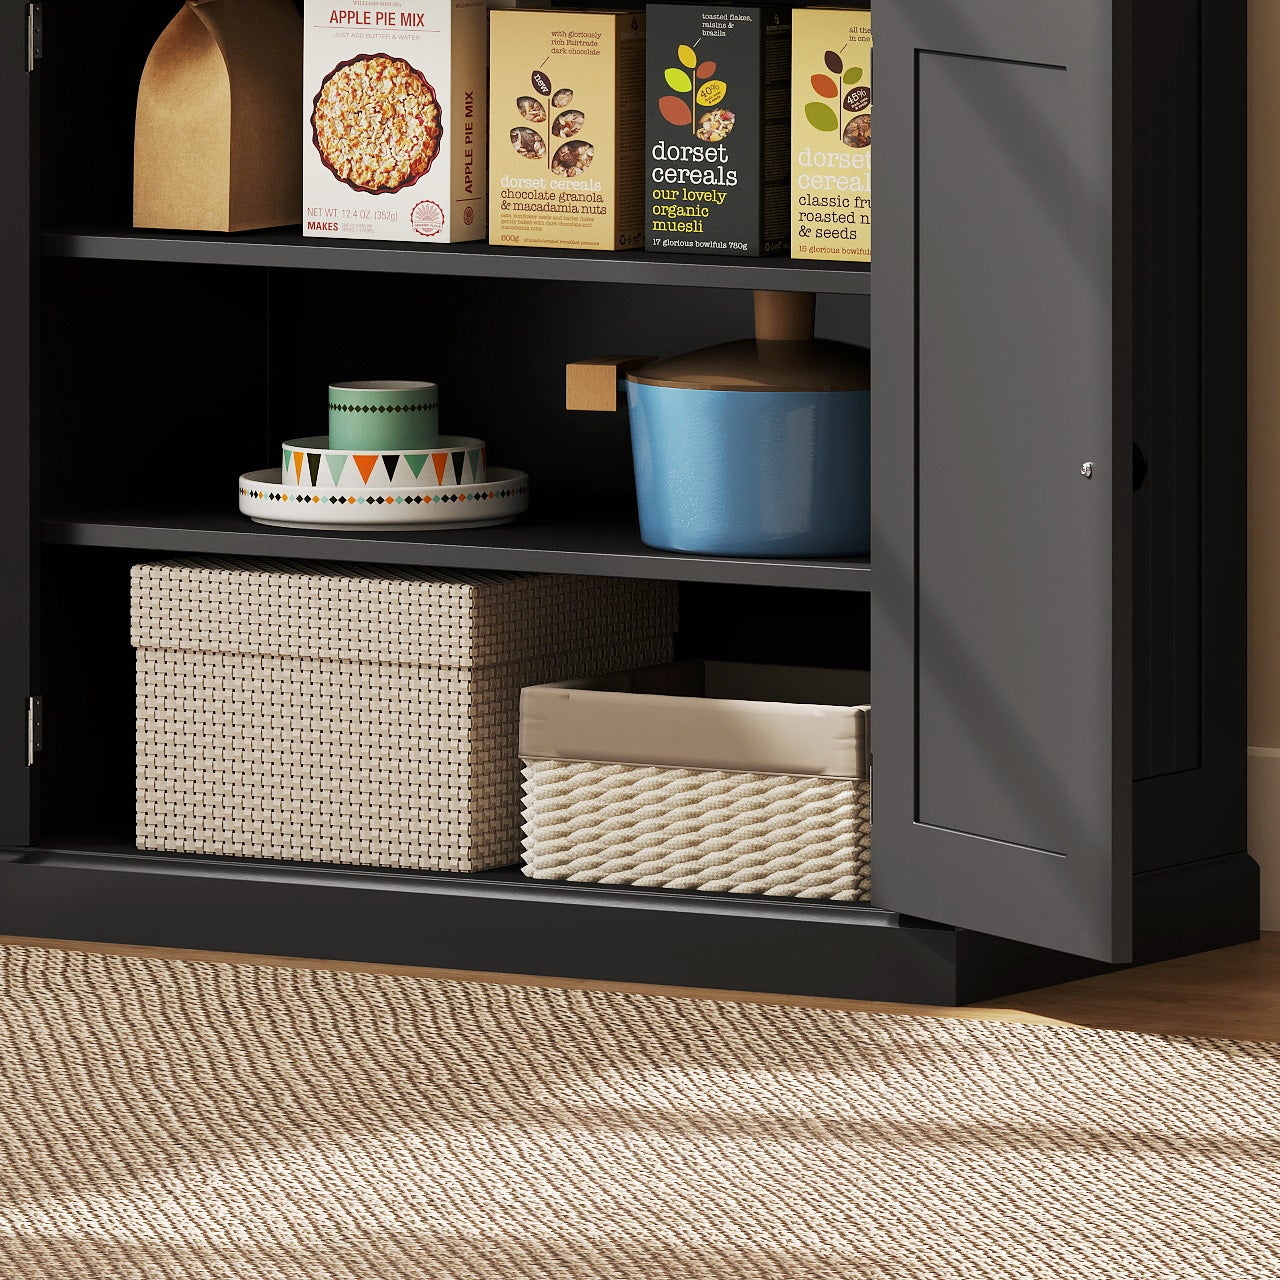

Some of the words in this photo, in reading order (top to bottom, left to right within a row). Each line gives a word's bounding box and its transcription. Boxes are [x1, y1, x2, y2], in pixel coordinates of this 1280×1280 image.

[329, 10, 371, 24] APPLE
[376, 11, 395, 26] PIE
[400, 12, 425, 27] MIX
[730, 14, 752, 22] flakes,
[568, 31, 602, 39] gloriously
[533, 73, 549, 93] new
[701, 83, 720, 97] 40%
[464, 90, 473, 118] MIX
[464, 122, 473, 144] PIE
[652, 141, 729, 163] dorset
[798, 148, 871, 169] dorset
[464, 149, 473, 194] APPLE
[652, 166, 738, 186] cereals
[500, 175, 546, 188] dorset
[550, 178, 601, 192] cereals
[501, 189, 556, 200] chocolate
[558, 192, 604, 203] granola
[652, 189, 679, 200] our
[682, 188, 727, 204] lovely
[798, 194, 850, 207] classic
[307, 208, 323, 217] NET
[501, 200, 511, 211] &
[513, 202, 579, 213] macadamia
[581, 205, 607, 214] nuts
[652, 204, 709, 218] organic
[798, 211, 856, 224] roasted
[307, 221, 339, 231] MAKES
[652, 220, 704, 233] muesli
[799, 225, 811, 238] &
[815, 227, 857, 240] seeds
[662, 239, 694, 248] glorious
[695, 240, 727, 249] bowlfuls
[728, 242, 748, 251] 780g
[809, 246, 840, 254] glorious
